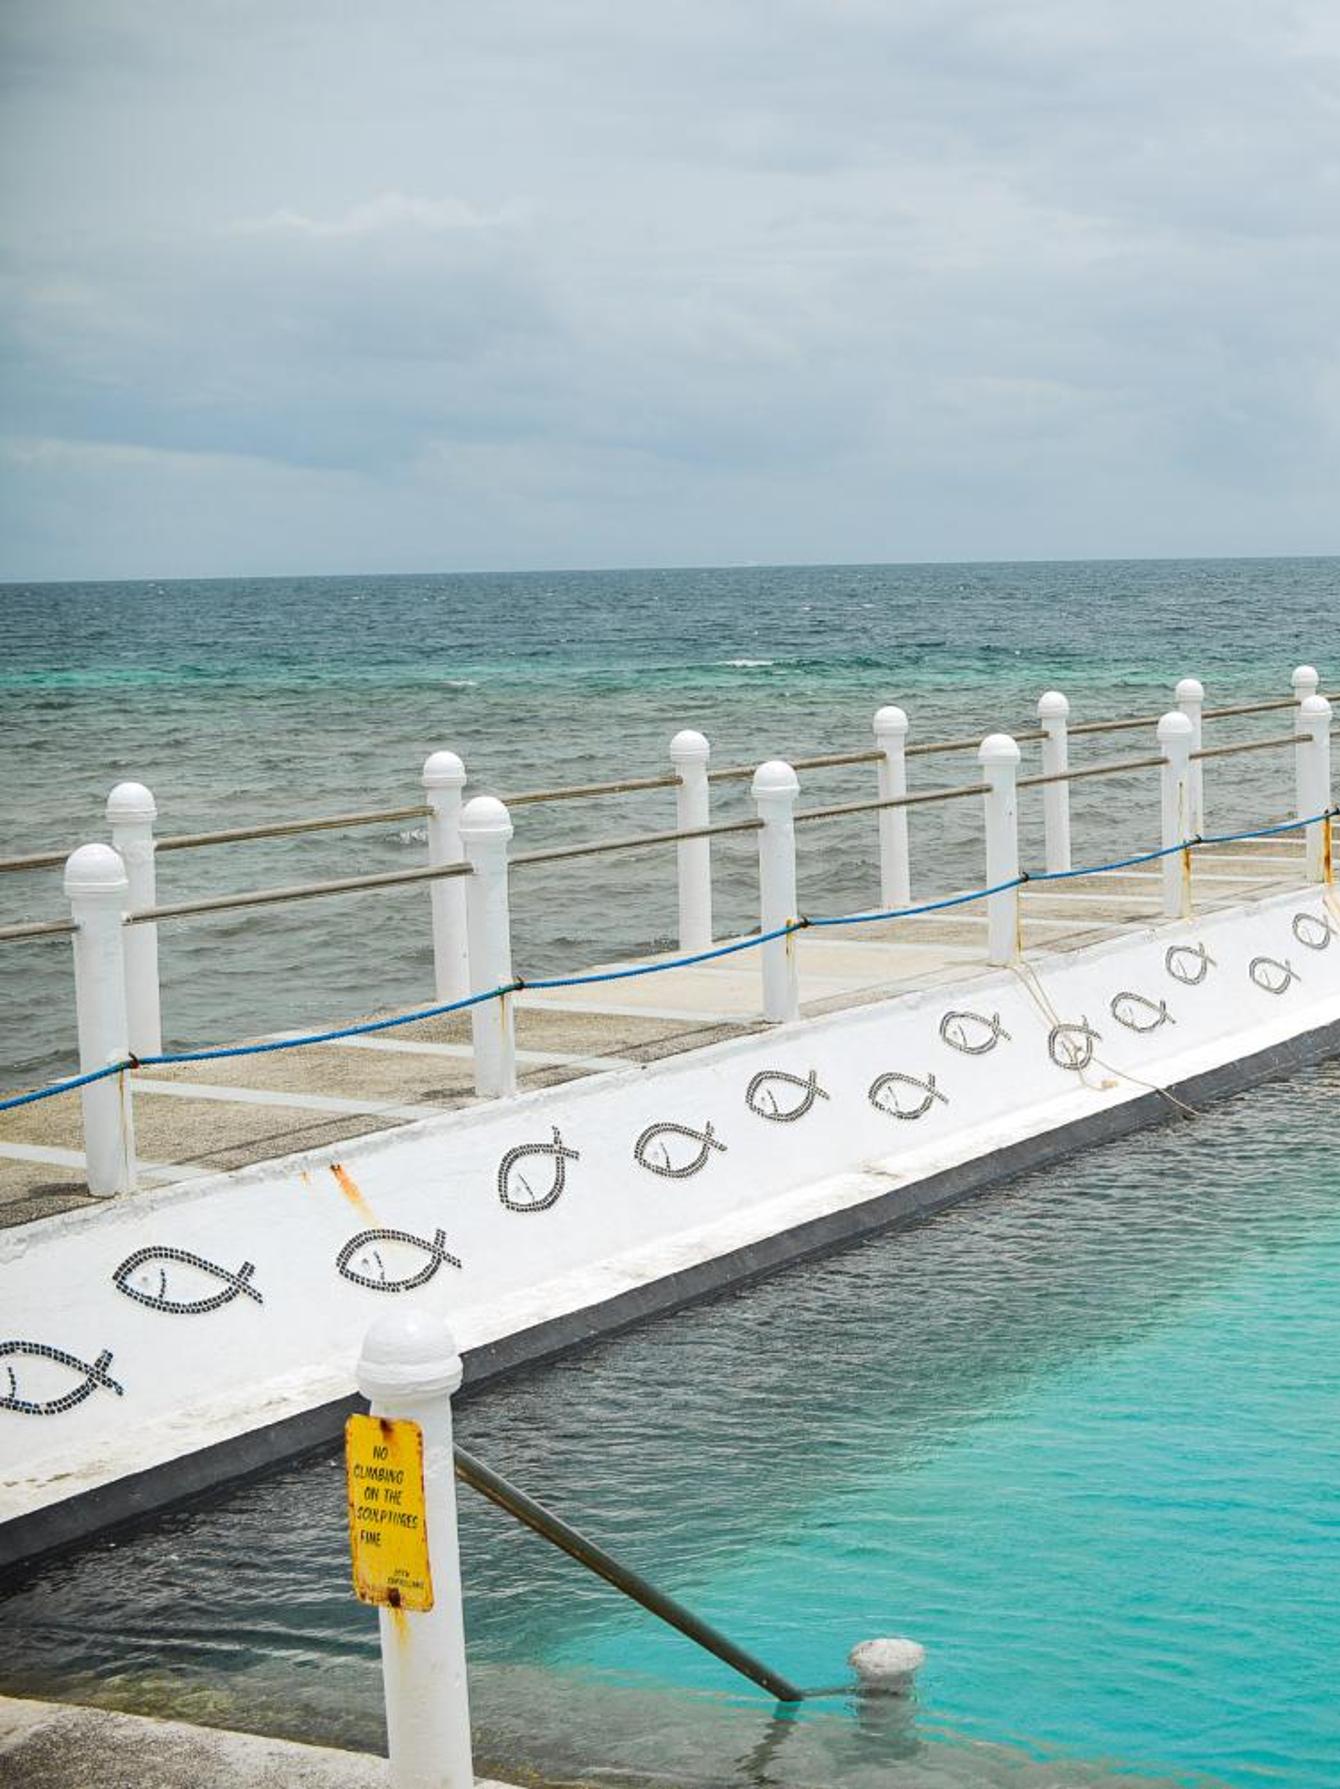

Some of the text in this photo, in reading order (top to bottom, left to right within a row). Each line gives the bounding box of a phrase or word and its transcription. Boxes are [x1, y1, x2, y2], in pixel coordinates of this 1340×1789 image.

[373, 1446, 388, 1460] NO
[354, 1464, 404, 1485] CLIMBING
[364, 1486, 403, 1506] ON THE
